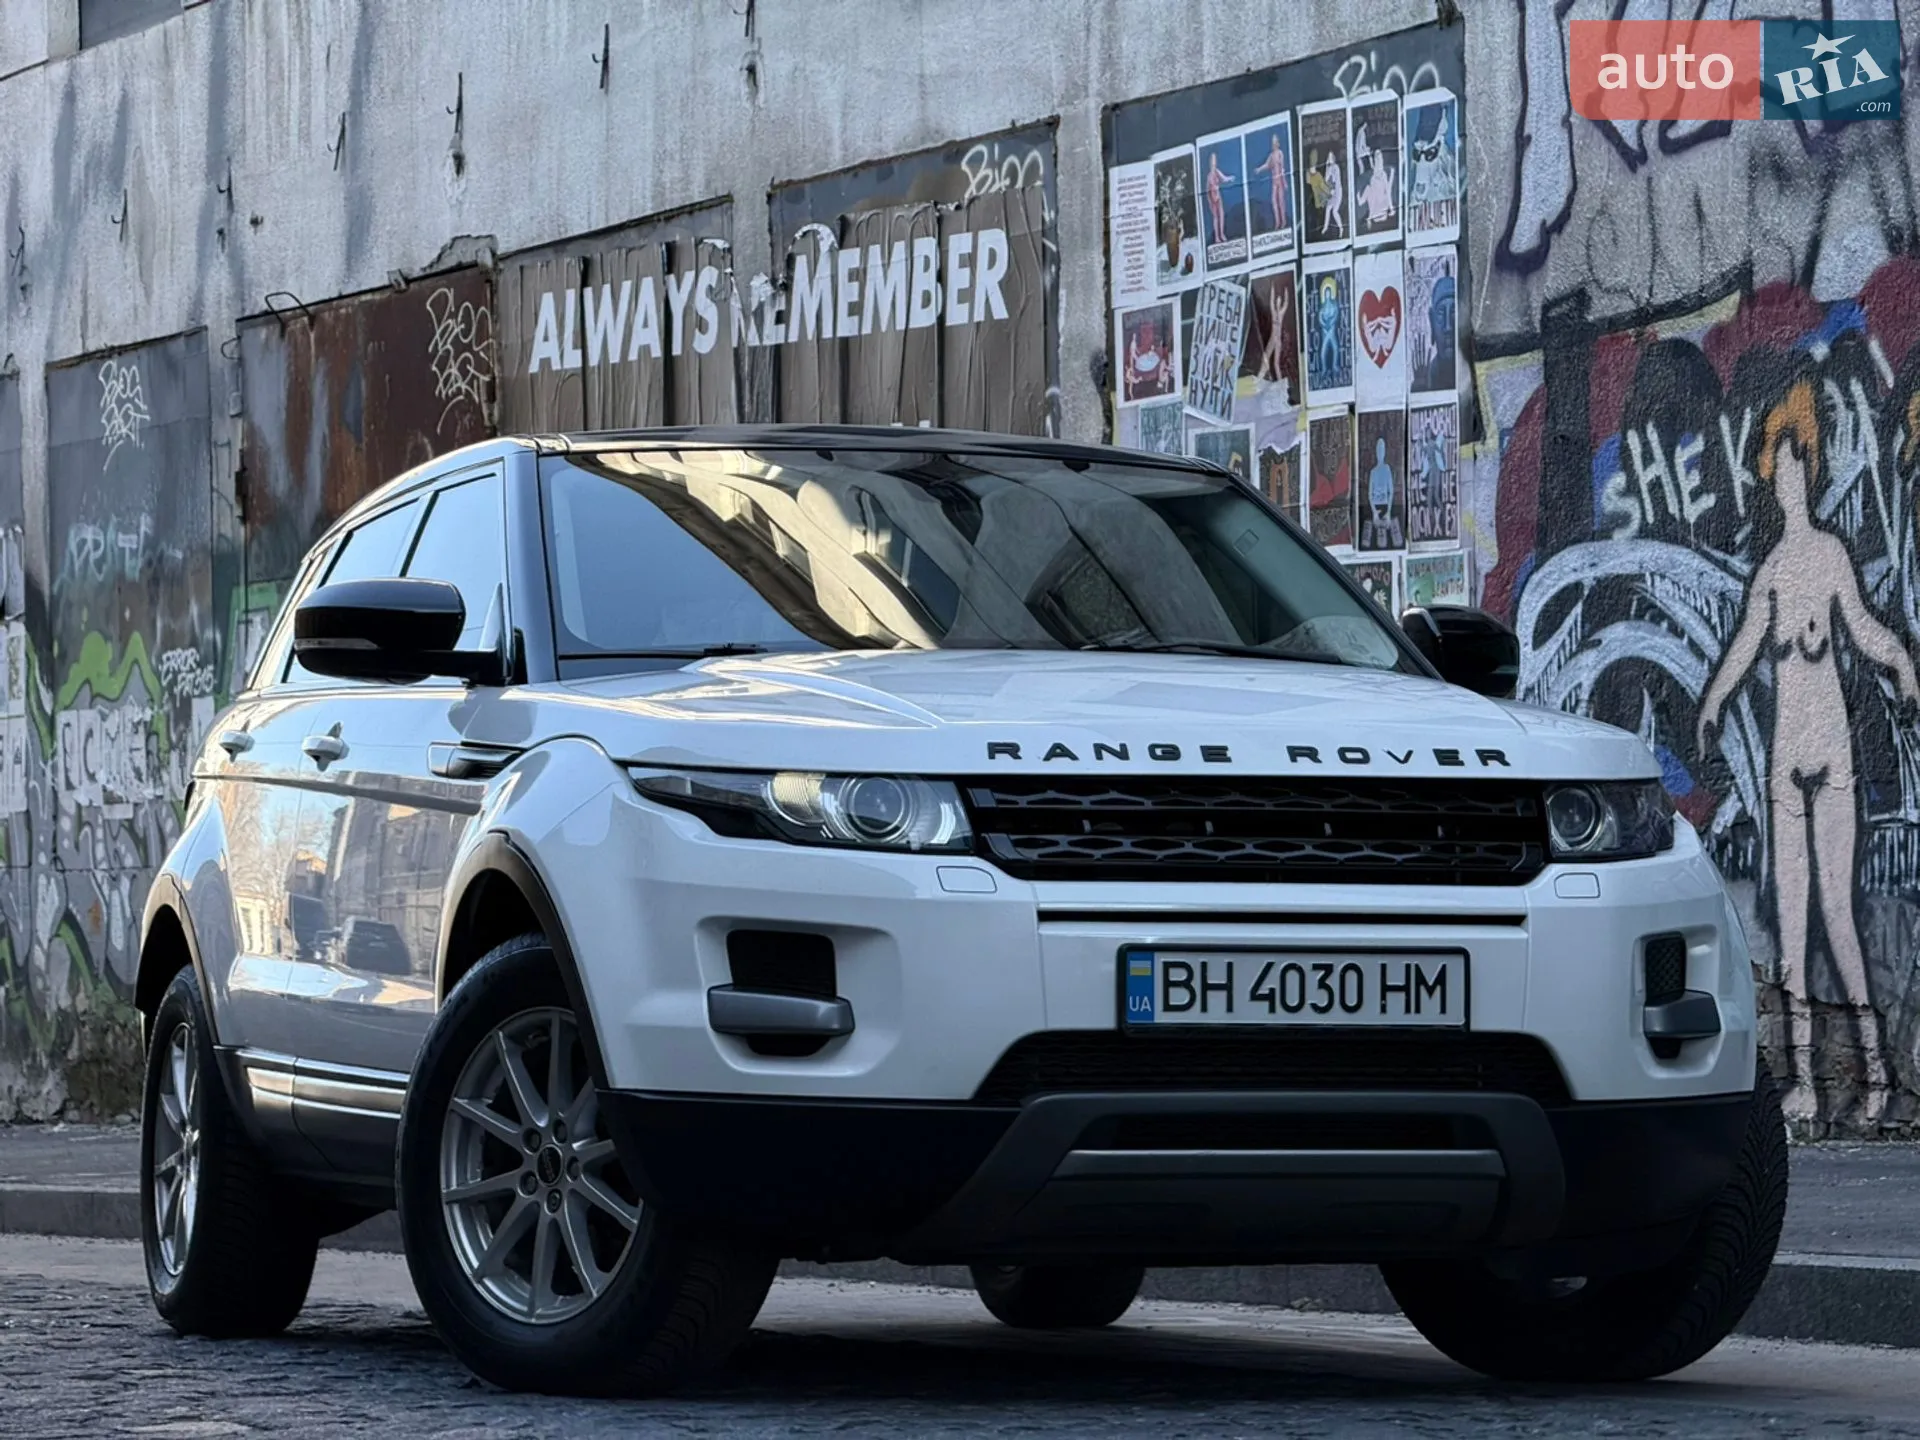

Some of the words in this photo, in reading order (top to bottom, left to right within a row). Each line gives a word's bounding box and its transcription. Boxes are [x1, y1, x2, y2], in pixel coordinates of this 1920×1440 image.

[528, 266, 720, 374] ALWAYS
[987, 742, 1232, 763] RANGE
[1286, 745, 1511, 767] ROVER
[1129, 995, 1151, 1012] UA
[1162, 961, 1233, 1013] BH
[1249, 961, 1364, 1014] 4030
[1380, 963, 1447, 1014] HM
